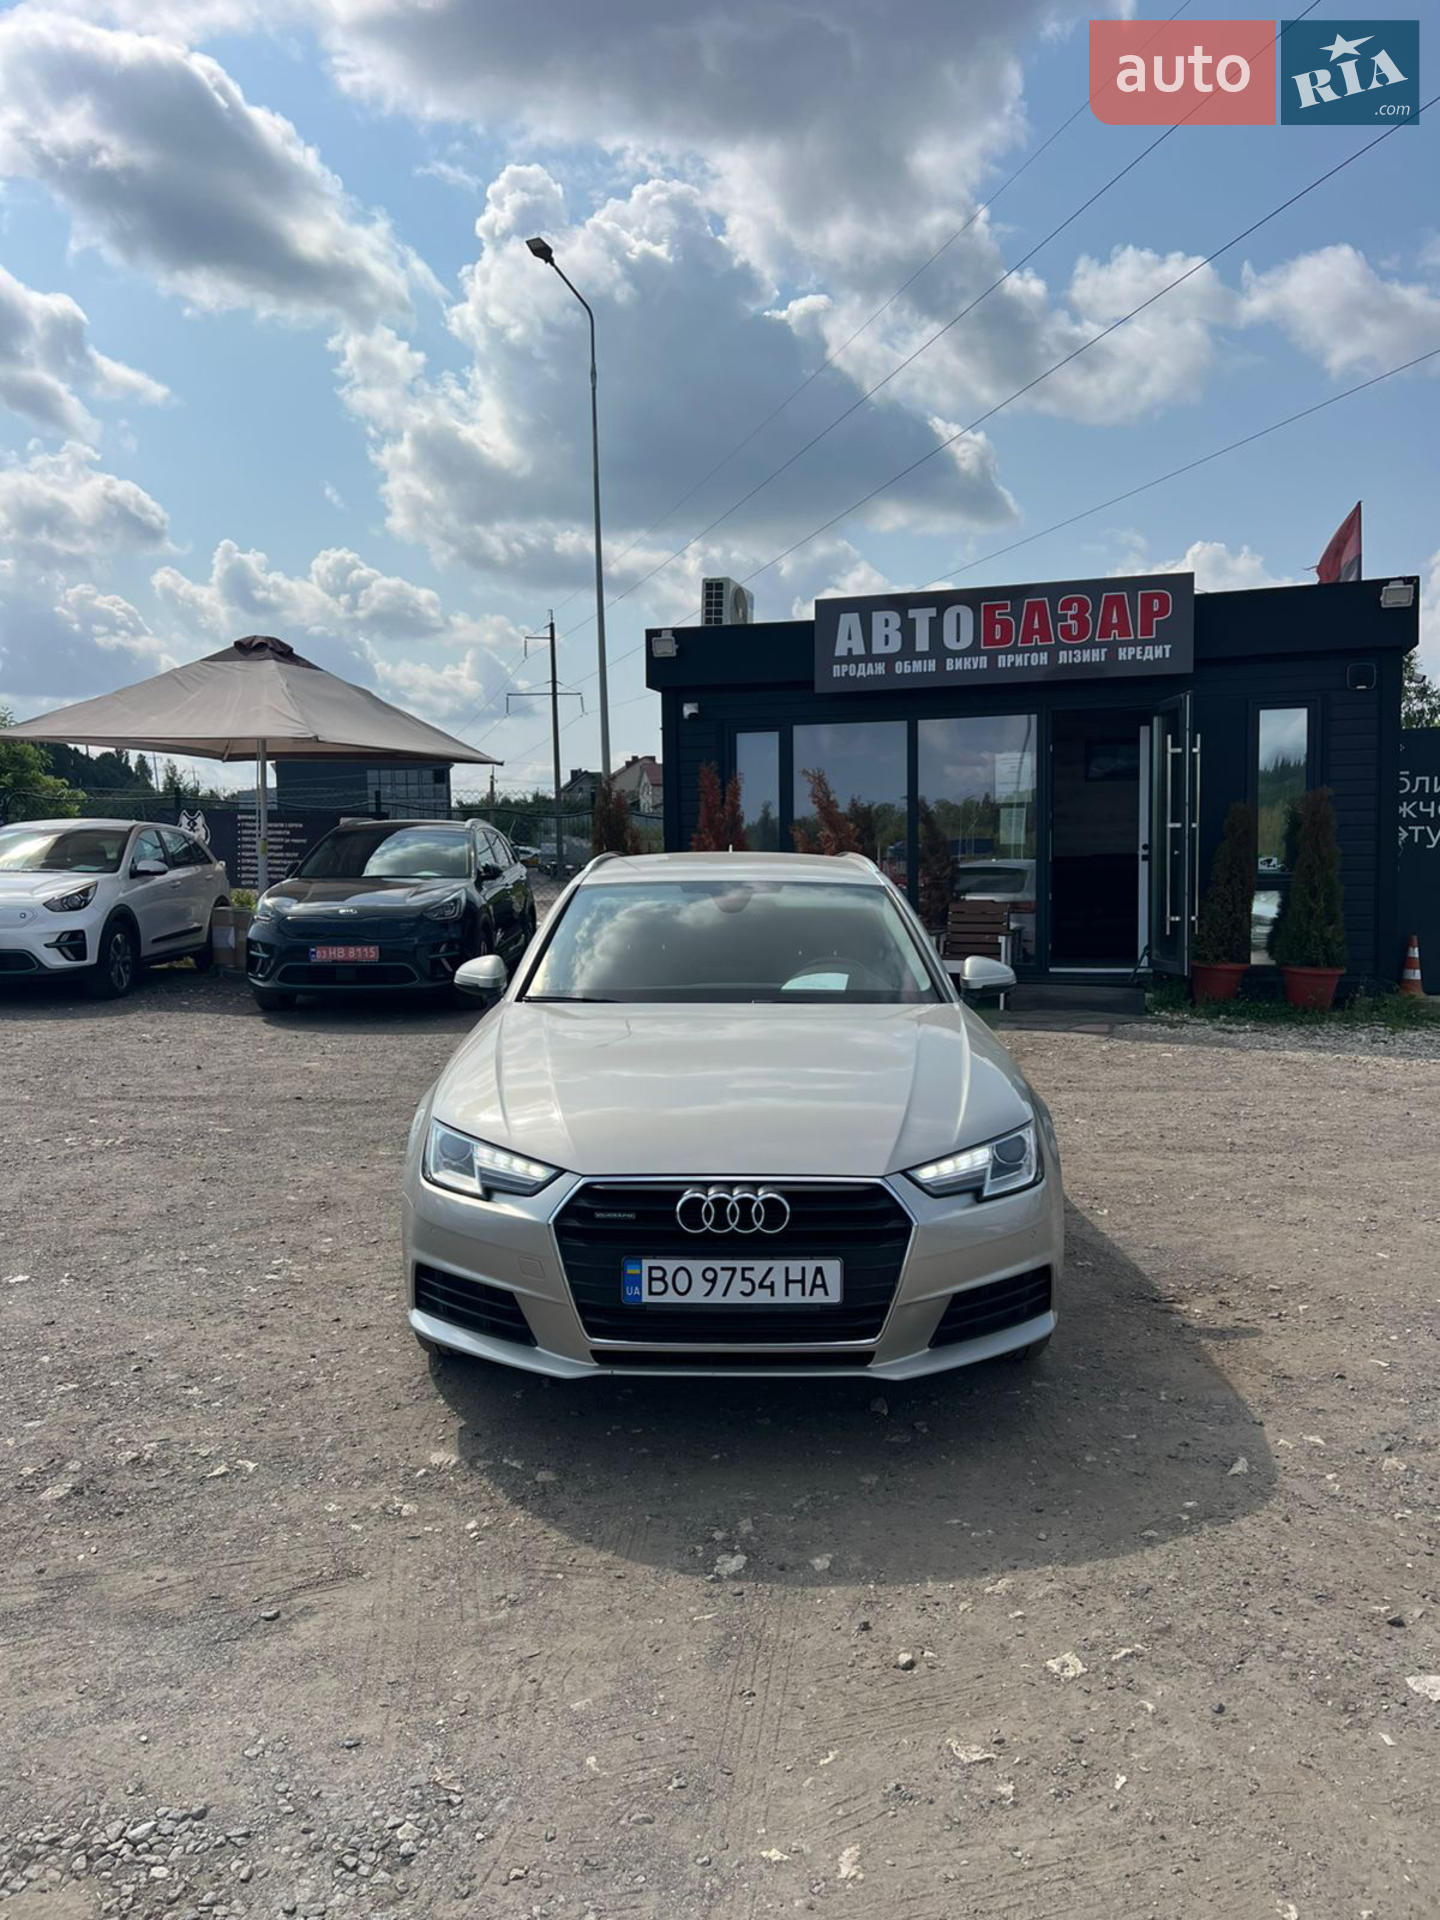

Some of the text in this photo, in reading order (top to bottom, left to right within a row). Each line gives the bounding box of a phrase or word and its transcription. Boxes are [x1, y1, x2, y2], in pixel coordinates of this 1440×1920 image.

[834, 589, 1173, 657] АВТОБАЗАР
[832, 644, 1172, 678] ПРОДАЖ ОБМІН ВИКУП ПРИГОН ЛІЗИНГ КРЕДИТ
[626, 1286, 640, 1296] UA
[648, 1266, 829, 1297] BO 9754 HA
